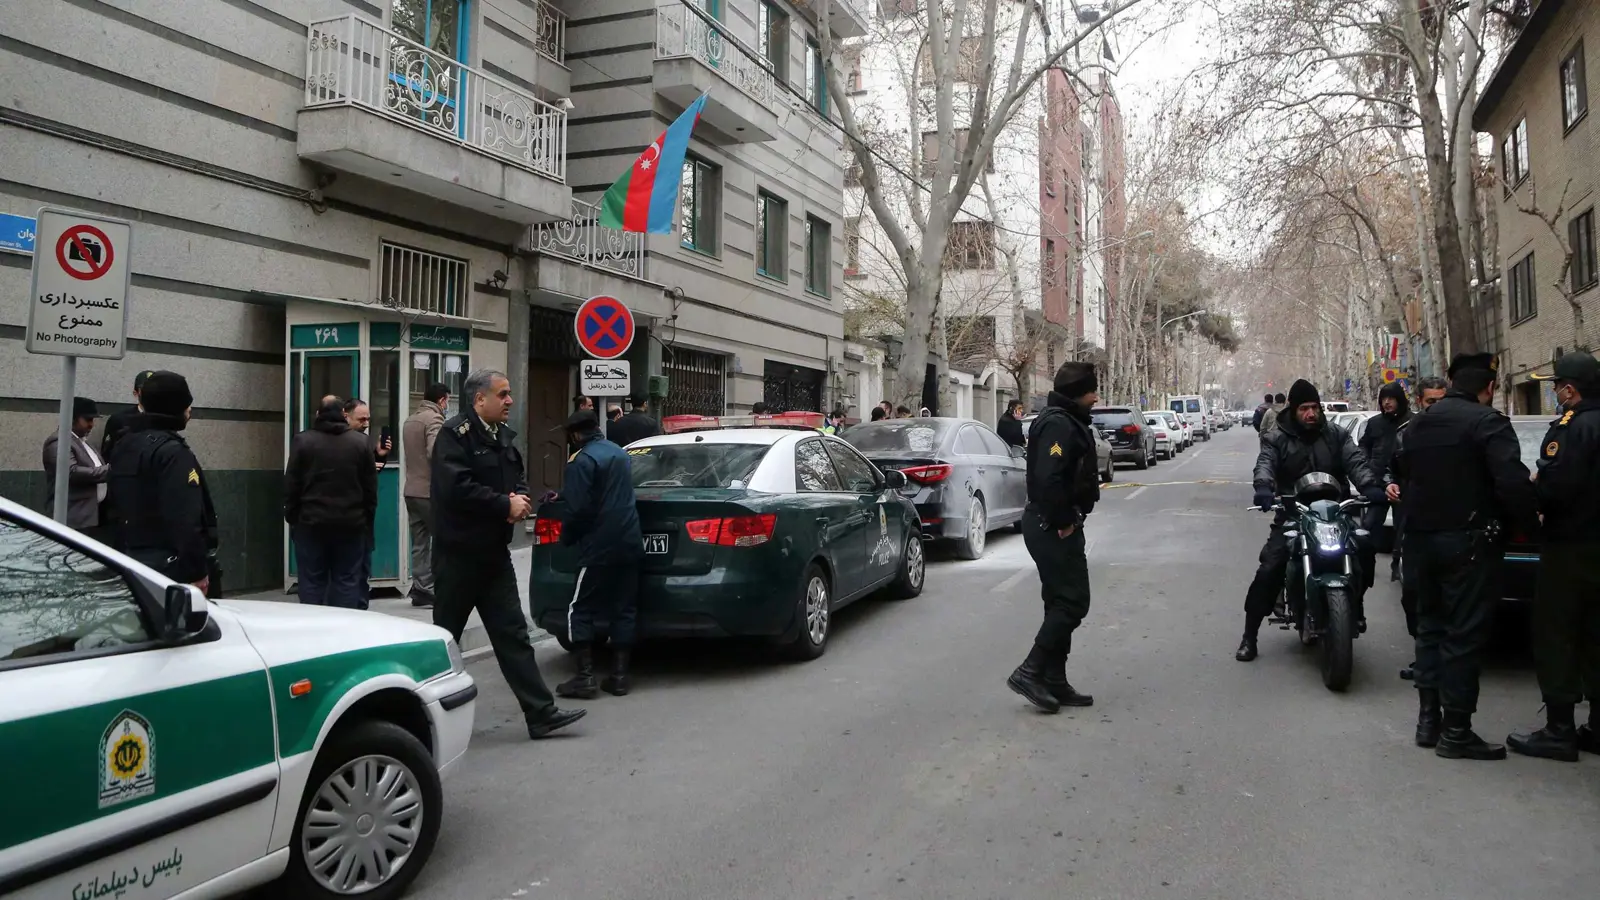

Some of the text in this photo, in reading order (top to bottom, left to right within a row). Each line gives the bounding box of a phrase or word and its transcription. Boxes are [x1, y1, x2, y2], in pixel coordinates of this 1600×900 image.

[40, 292, 119, 309] عکسبرداری
[58, 314, 103, 329] ممنوع
[36, 332, 117, 348] No Photography
[142, 847, 183, 888] پلیس
